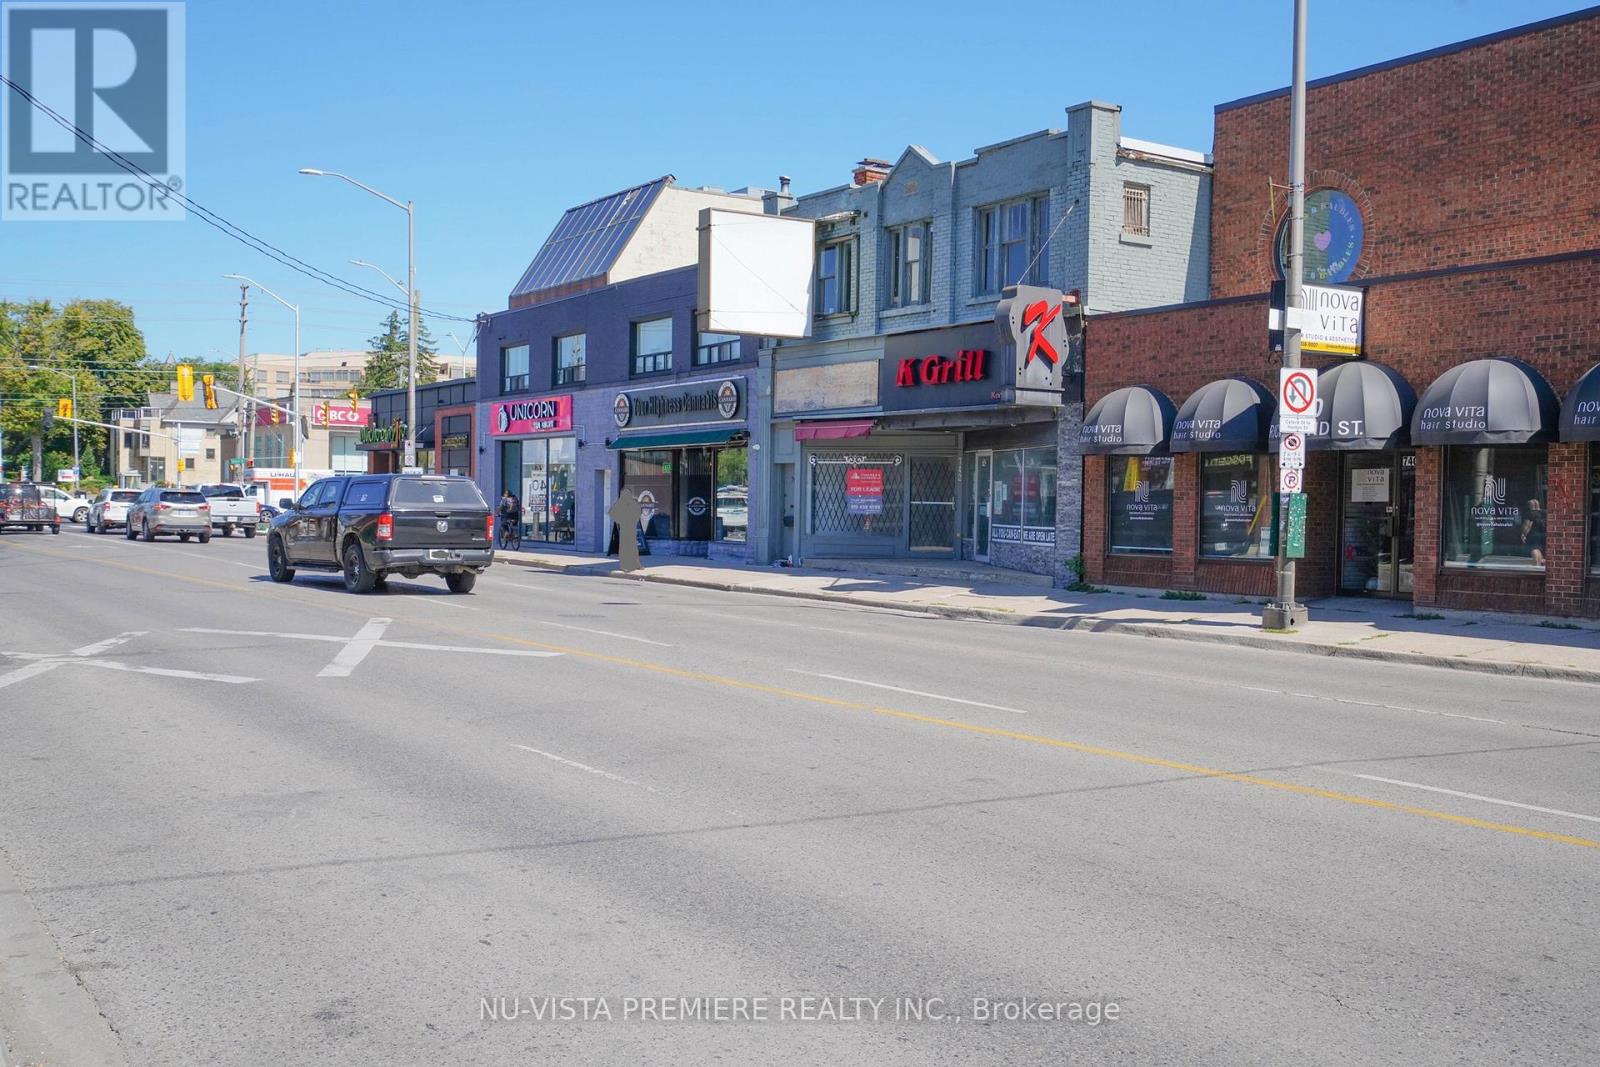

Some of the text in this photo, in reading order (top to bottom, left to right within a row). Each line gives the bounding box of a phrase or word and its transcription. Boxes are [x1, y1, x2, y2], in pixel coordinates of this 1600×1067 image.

[1320, 291, 1359, 311] nova
[896, 349, 985, 387] K Grill
[510, 401, 555, 421] UNICORN
[1424, 406, 1451, 419] nova
[1577, 401, 1600, 413] nov
[317, 410, 345, 420] CBC
[1573, 414, 1596, 425] hair
[1176, 421, 1195, 430] nova
[1337, 420, 1364, 436] ST.
[1421, 417, 1486, 430] hair studio
[1093, 434, 1122, 443] studio
[1173, 429, 1222, 440] hair studio
[1126, 503, 1142, 511] nova
[1471, 506, 1496, 515] nova
[1046, 532, 1055, 542] LATE
